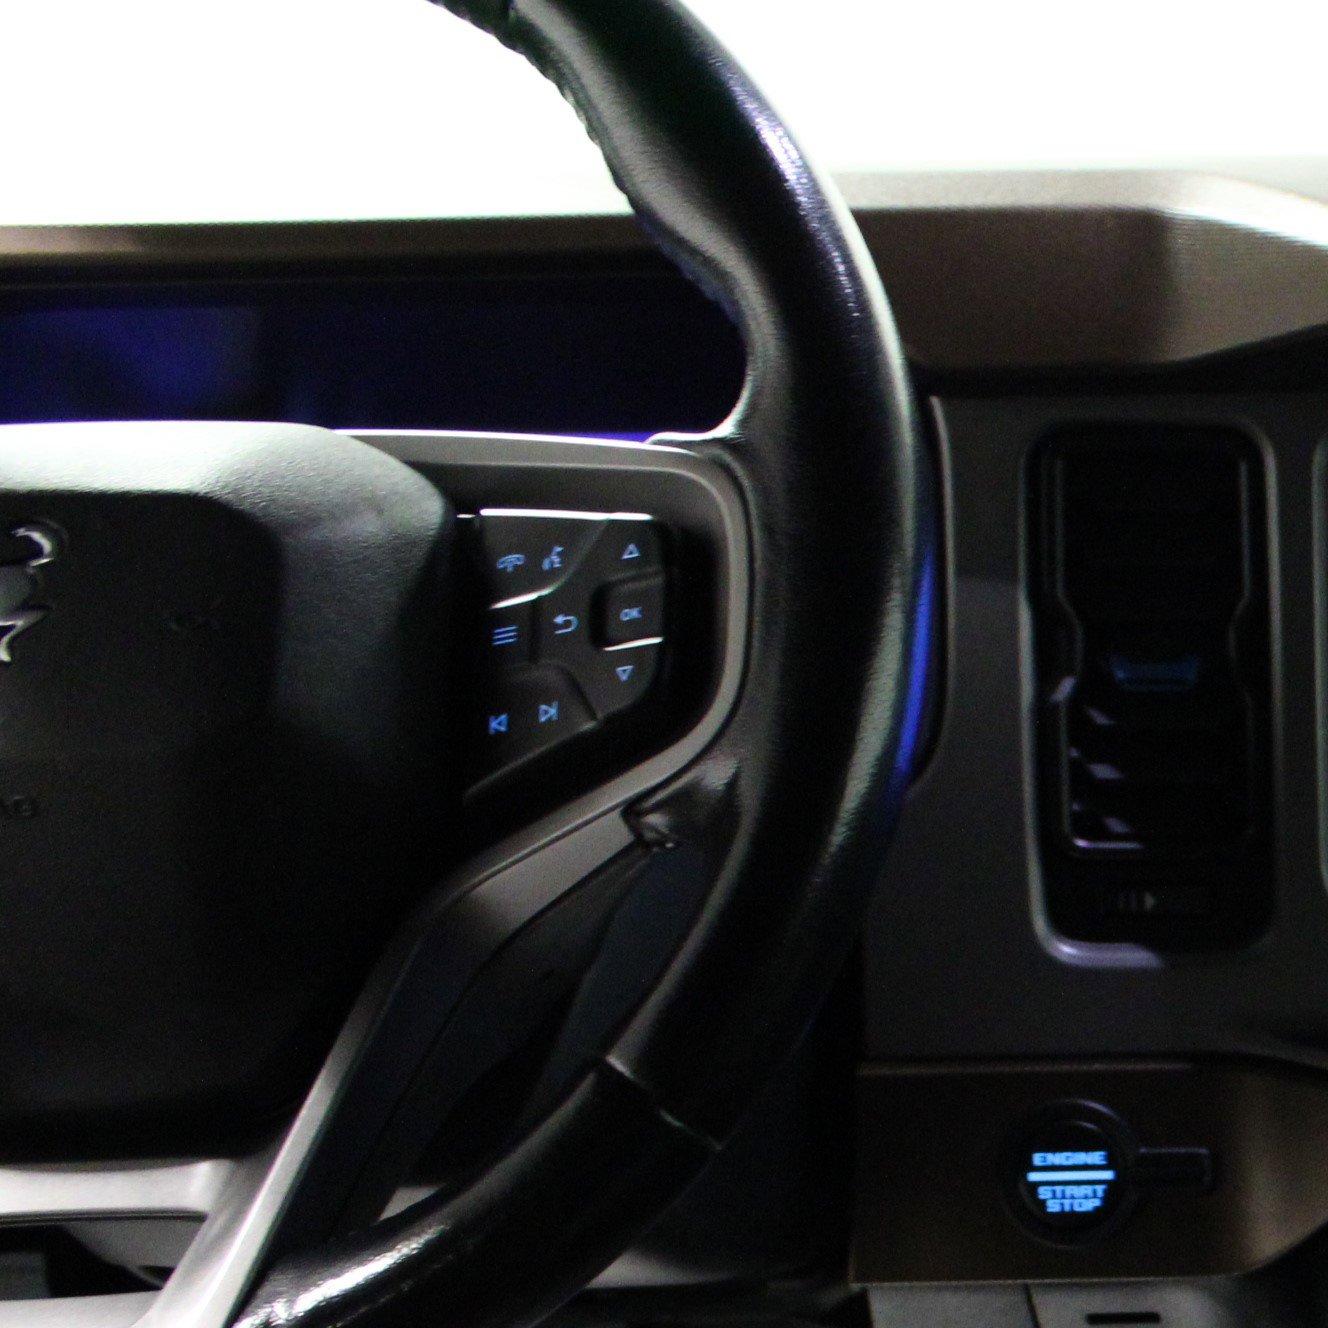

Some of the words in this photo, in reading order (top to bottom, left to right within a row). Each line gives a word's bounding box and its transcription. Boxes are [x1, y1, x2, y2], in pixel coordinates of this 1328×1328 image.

[619, 606, 643, 622] OK
[1032, 1151, 1108, 1166] ENGINE
[1037, 1184, 1107, 1199] START
[1046, 1199, 1102, 1213] STOP
